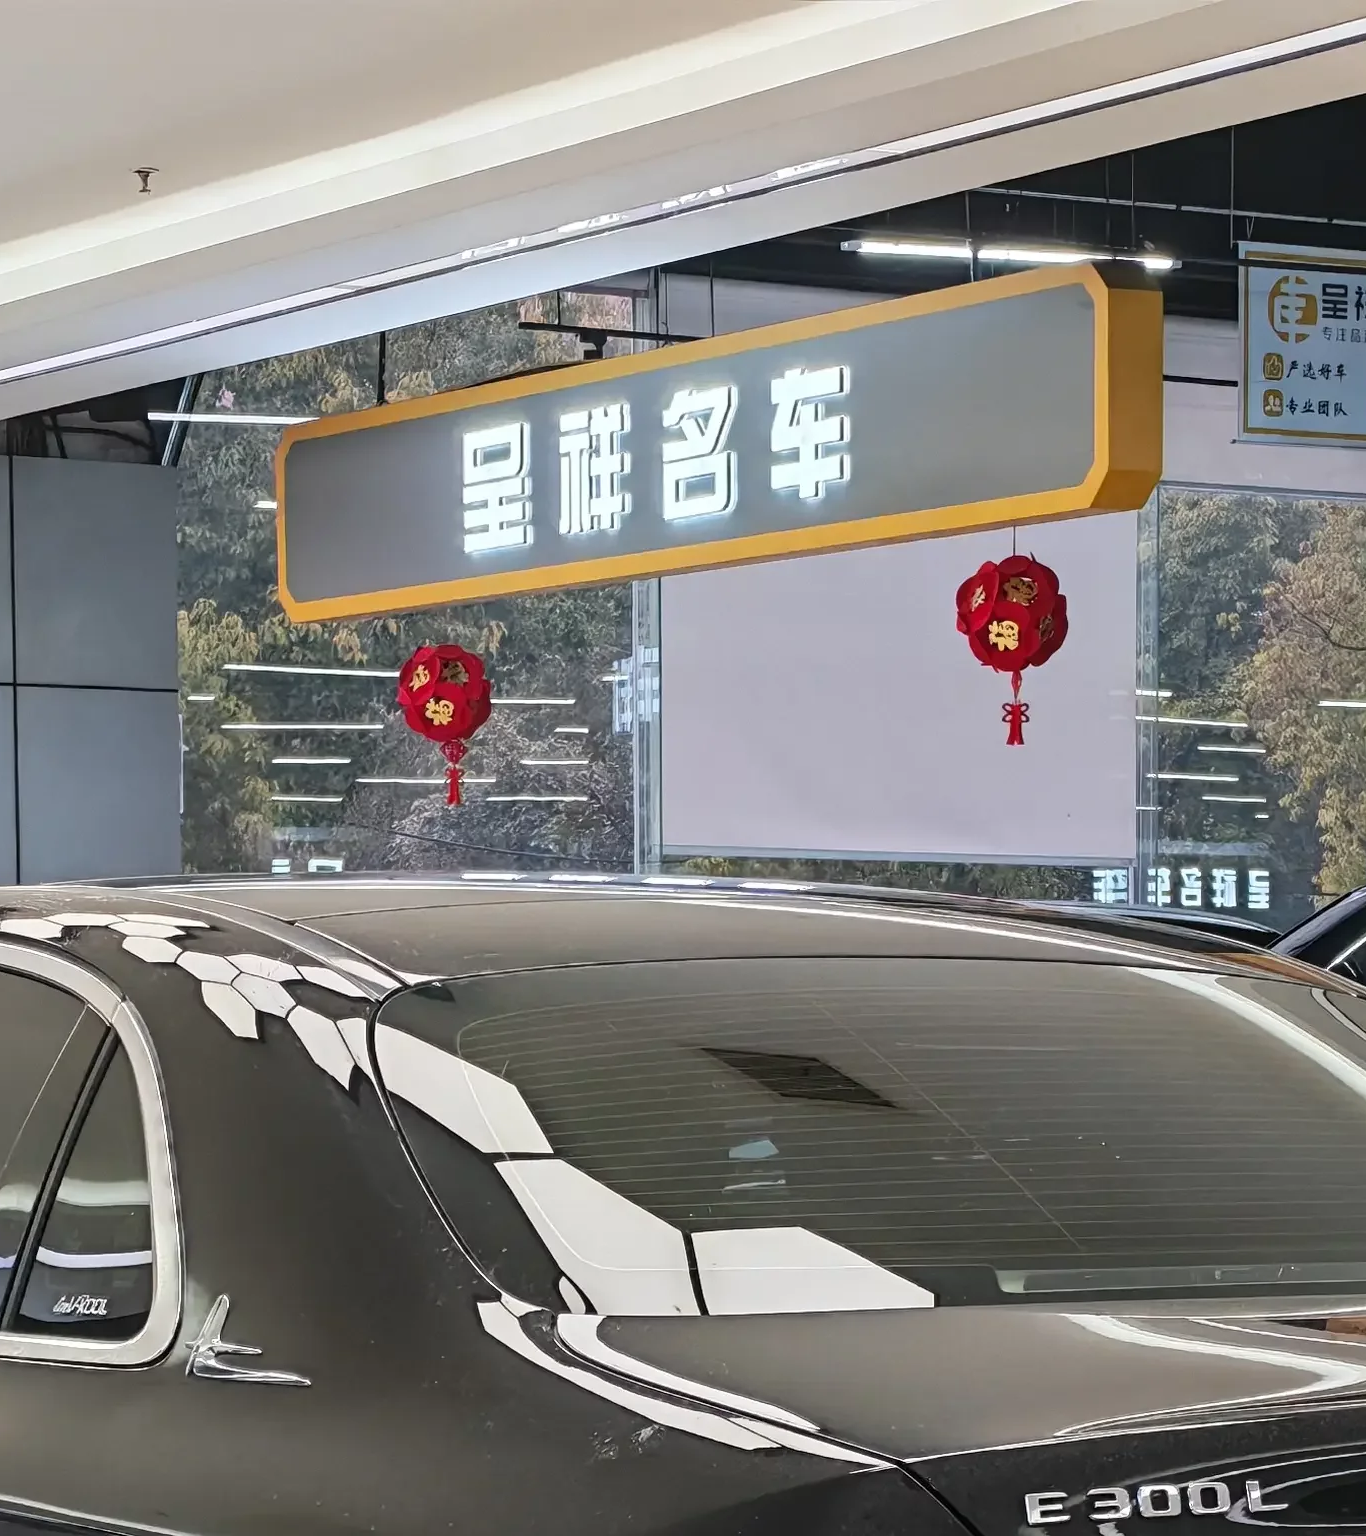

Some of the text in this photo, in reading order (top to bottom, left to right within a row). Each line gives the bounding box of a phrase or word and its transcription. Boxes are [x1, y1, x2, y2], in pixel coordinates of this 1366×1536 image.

[1286, 360, 1348, 382] 严选好车
[1286, 396, 1349, 418] 专业团队
[462, 363, 852, 555] 呈祥名车
